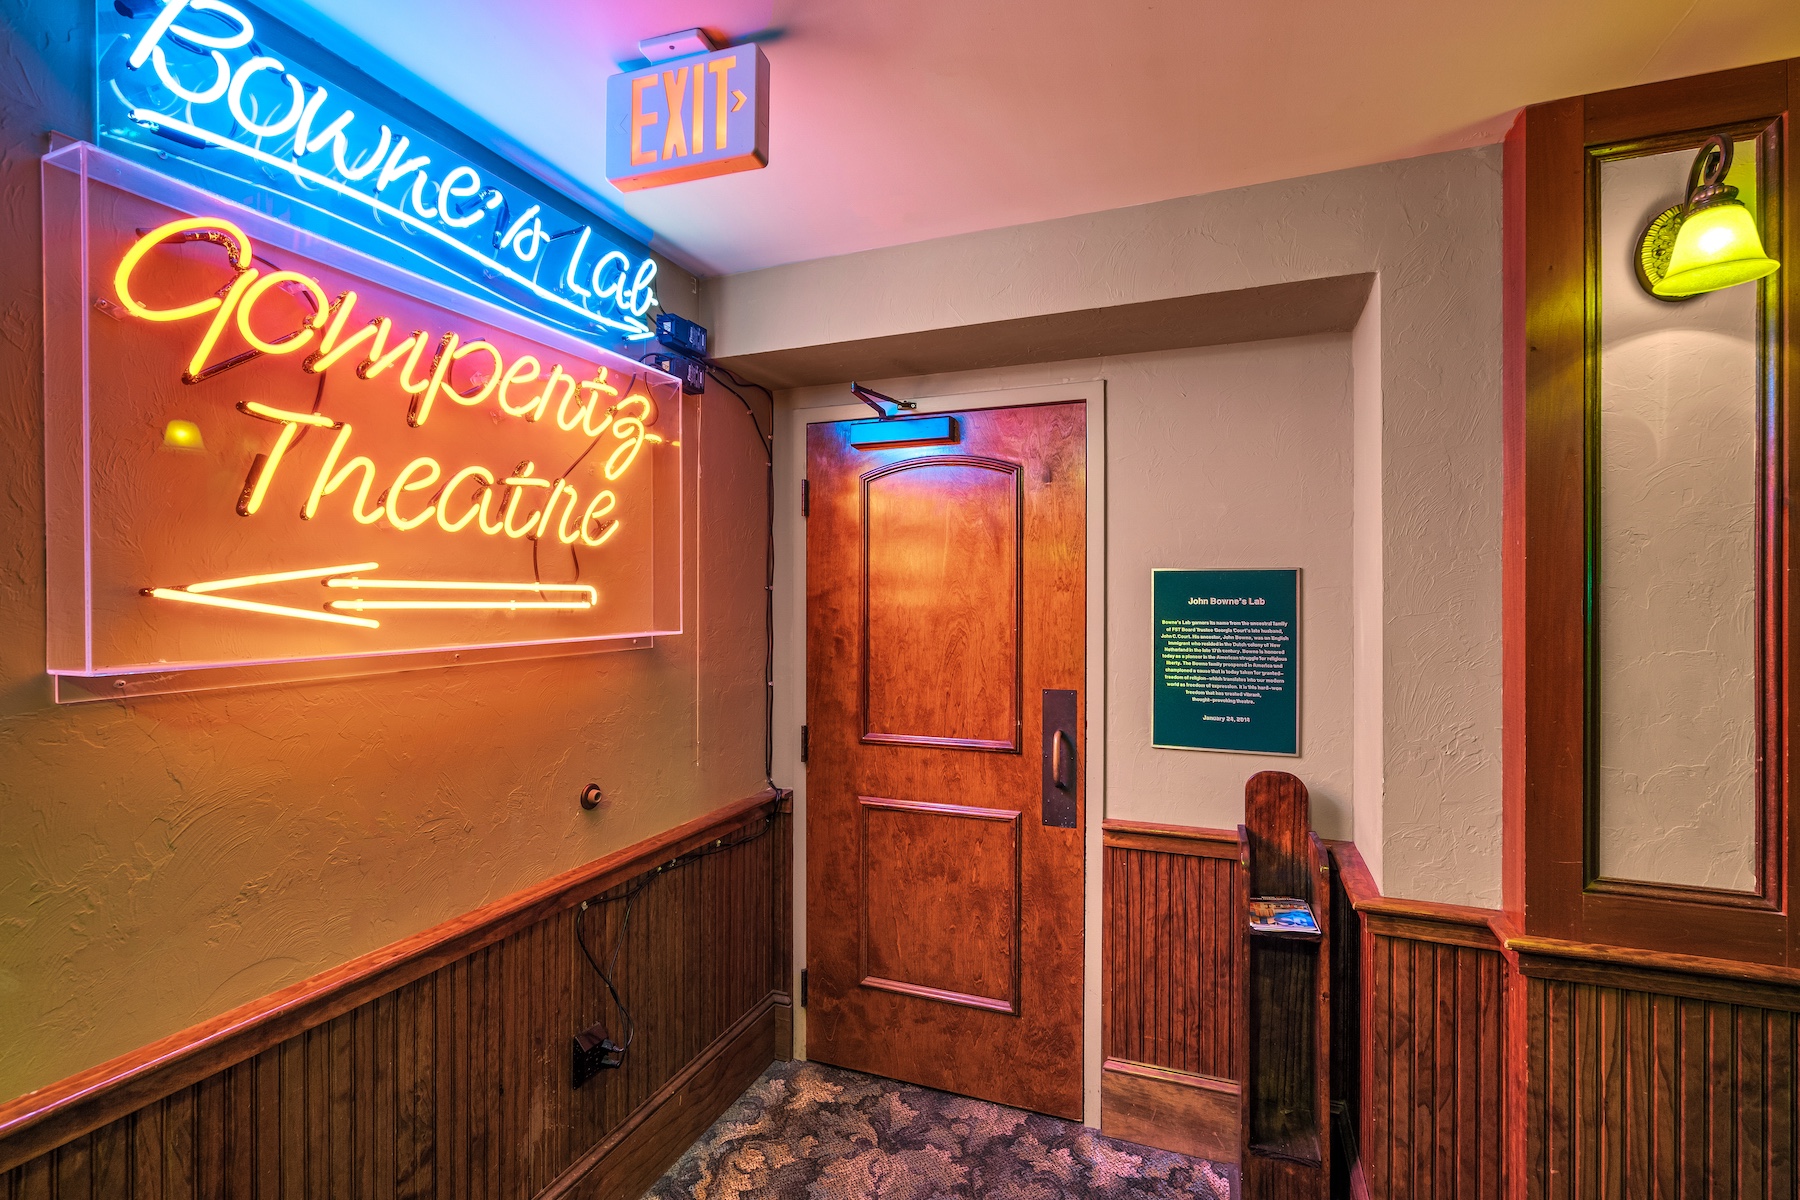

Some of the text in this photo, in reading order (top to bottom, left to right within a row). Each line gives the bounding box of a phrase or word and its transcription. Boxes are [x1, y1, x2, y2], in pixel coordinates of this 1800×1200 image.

[127, 0, 552, 262] Bowne's
[630, 55, 737, 167] EXIT
[113, 216, 662, 480] Gompertz
[238, 401, 620, 547] Theatre
[1187, 597, 1266, 606] John Bowne's Lab
[1202, 714, 1225, 722] January
